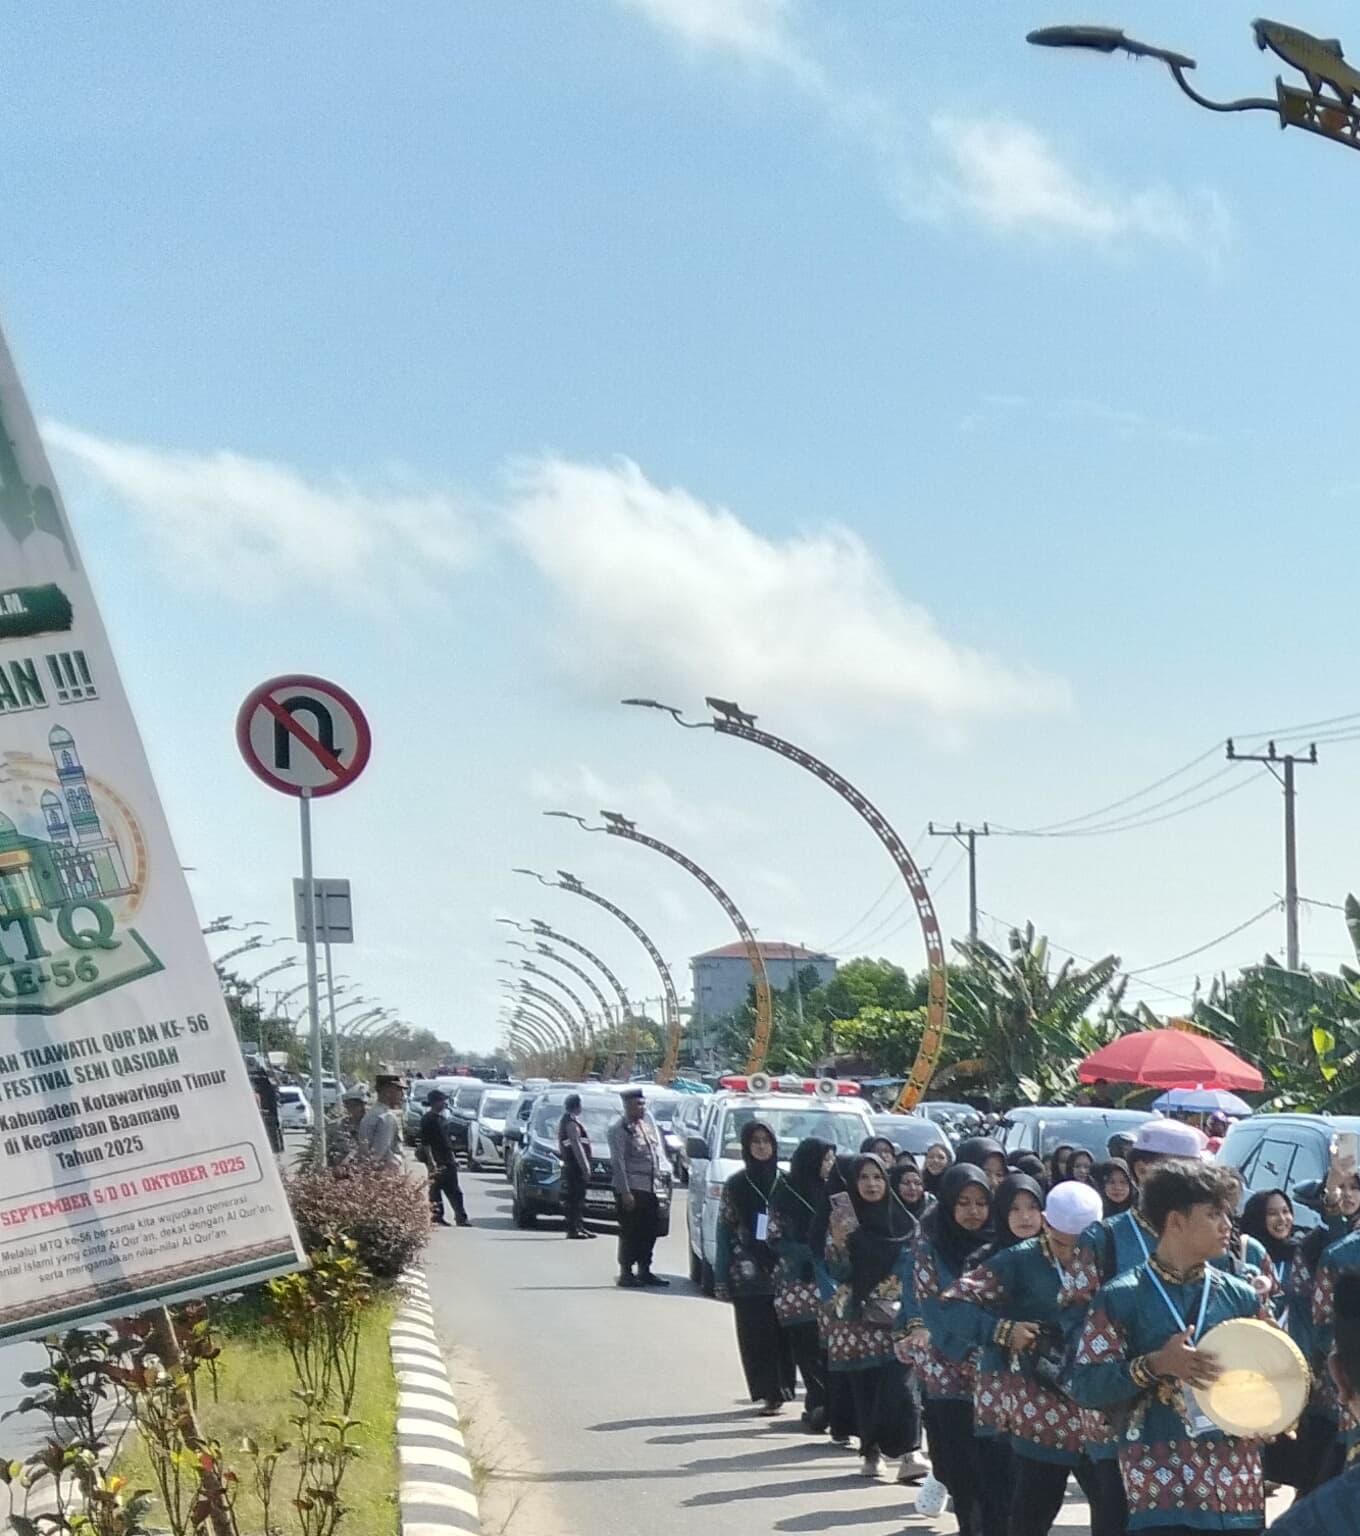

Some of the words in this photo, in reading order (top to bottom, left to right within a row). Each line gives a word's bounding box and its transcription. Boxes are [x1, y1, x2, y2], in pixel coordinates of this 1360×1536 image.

[46, 650, 97, 701] !!!
[20, 1037, 101, 1069] TILAWATIL
[102, 1023, 158, 1053] QUR'AN
[187, 1013, 209, 1034] 56
[0, 1100, 81, 1131] Kabupaten
[81, 1079, 183, 1113] Kotawaringin
[182, 1069, 227, 1091] Timur
[4, 1068, 73, 1100] FESTIVAL
[73, 1062, 110, 1084] SENI
[112, 1046, 180, 1076] QASIDAH
[4, 1135, 19, 1156] di
[21, 1121, 108, 1152] Kecamatan
[108, 1103, 181, 1131] Baamang
[56, 1146, 104, 1169] Tahun
[104, 1135, 145, 1158] 2025
[1, 1192, 92, 1226] SEPTEMBER
[94, 1186, 118, 1204] S/D
[120, 1181, 138, 1197] 01
[141, 1165, 208, 1192] OKTOBER
[211, 1156, 246, 1176] 2025
[1, 1246, 37, 1262] Melalui
[40, 1238, 62, 1252] MTQ
[93, 1222, 136, 1240] bersama
[138, 1217, 155, 1228] kita
[206, 1194, 248, 1214] generasi
[24, 1258, 54, 1273] islami
[55, 1252, 80, 1267] yang
[82, 1244, 107, 1257] cinta
[160, 1223, 187, 1238] dekat
[189, 1214, 224, 1229] dengan
[66, 1254, 134, 1275] mengamalkan
